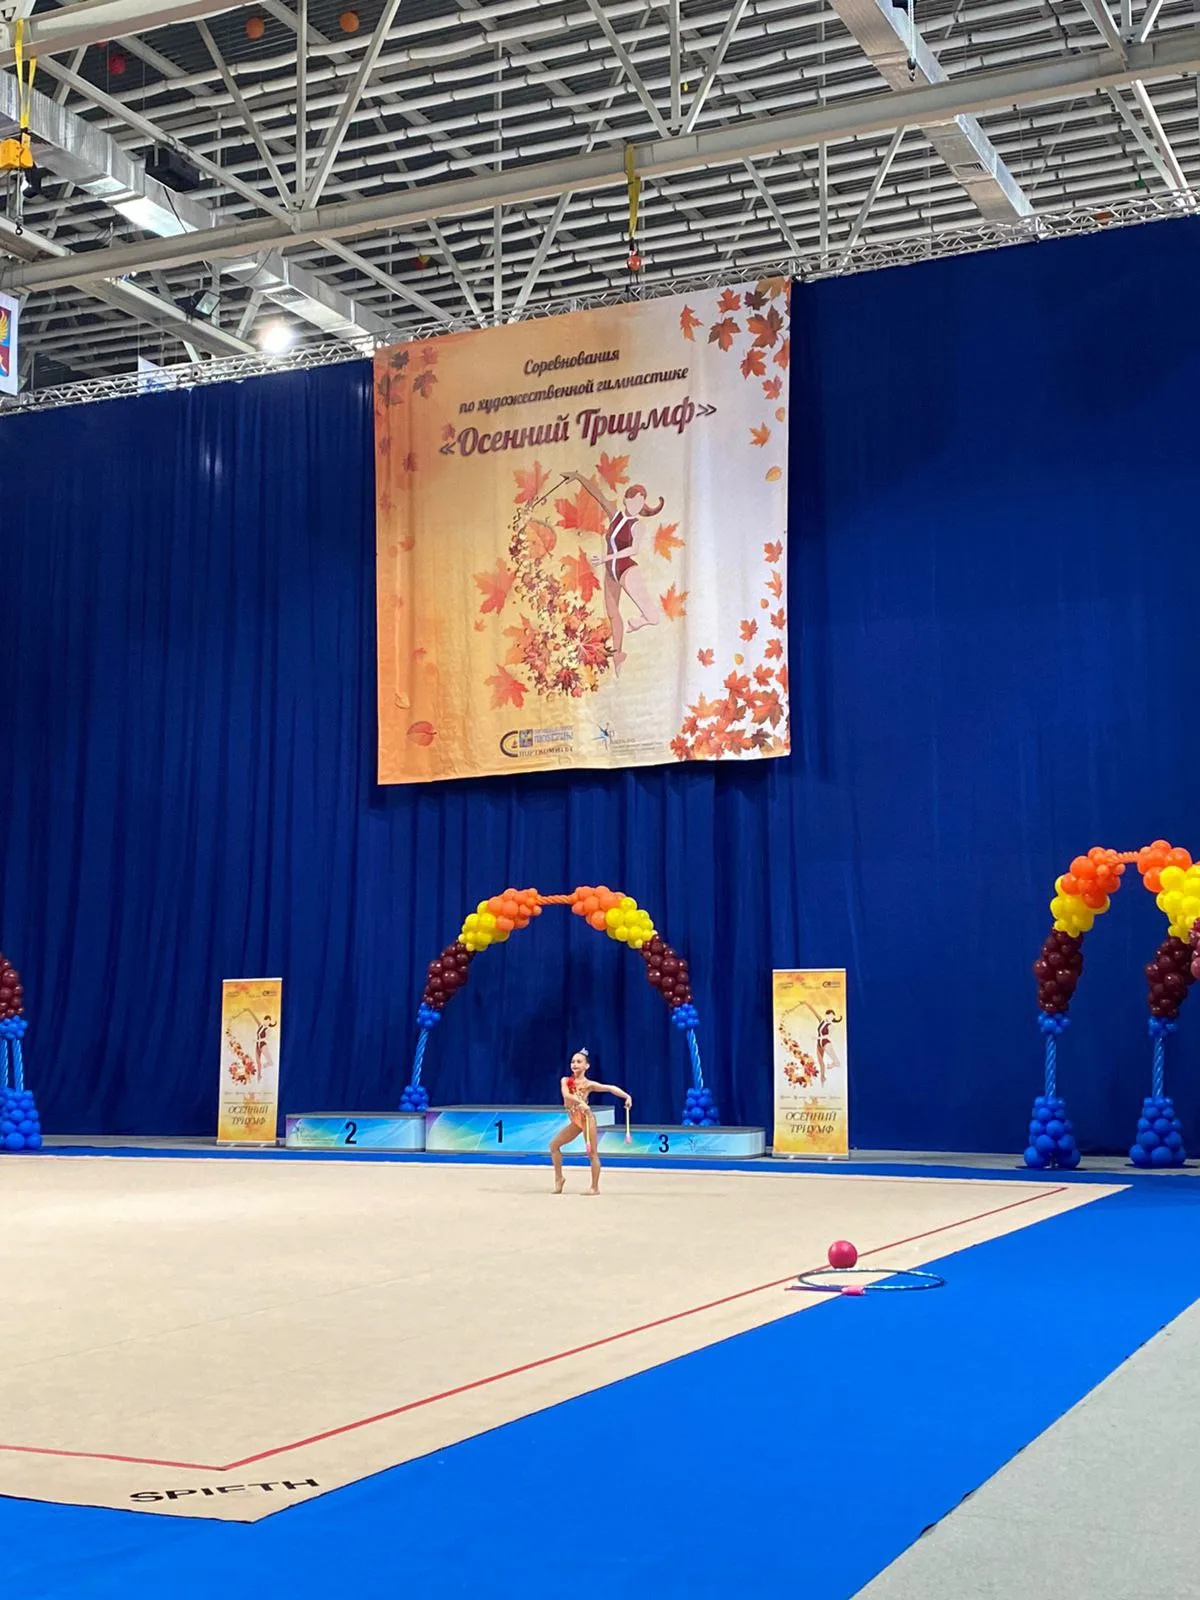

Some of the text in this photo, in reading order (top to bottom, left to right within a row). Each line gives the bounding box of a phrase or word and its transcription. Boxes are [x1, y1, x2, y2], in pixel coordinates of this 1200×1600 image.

[523, 349, 620, 377] Соревнования
[459, 367, 690, 416] по художественной гимнастике
[439, 396, 718, 457] «Осенний Триумф»
[344, 1121, 357, 1145] 2
[493, 1119, 503, 1144] 1
[658, 1134, 670, 1153] 3
